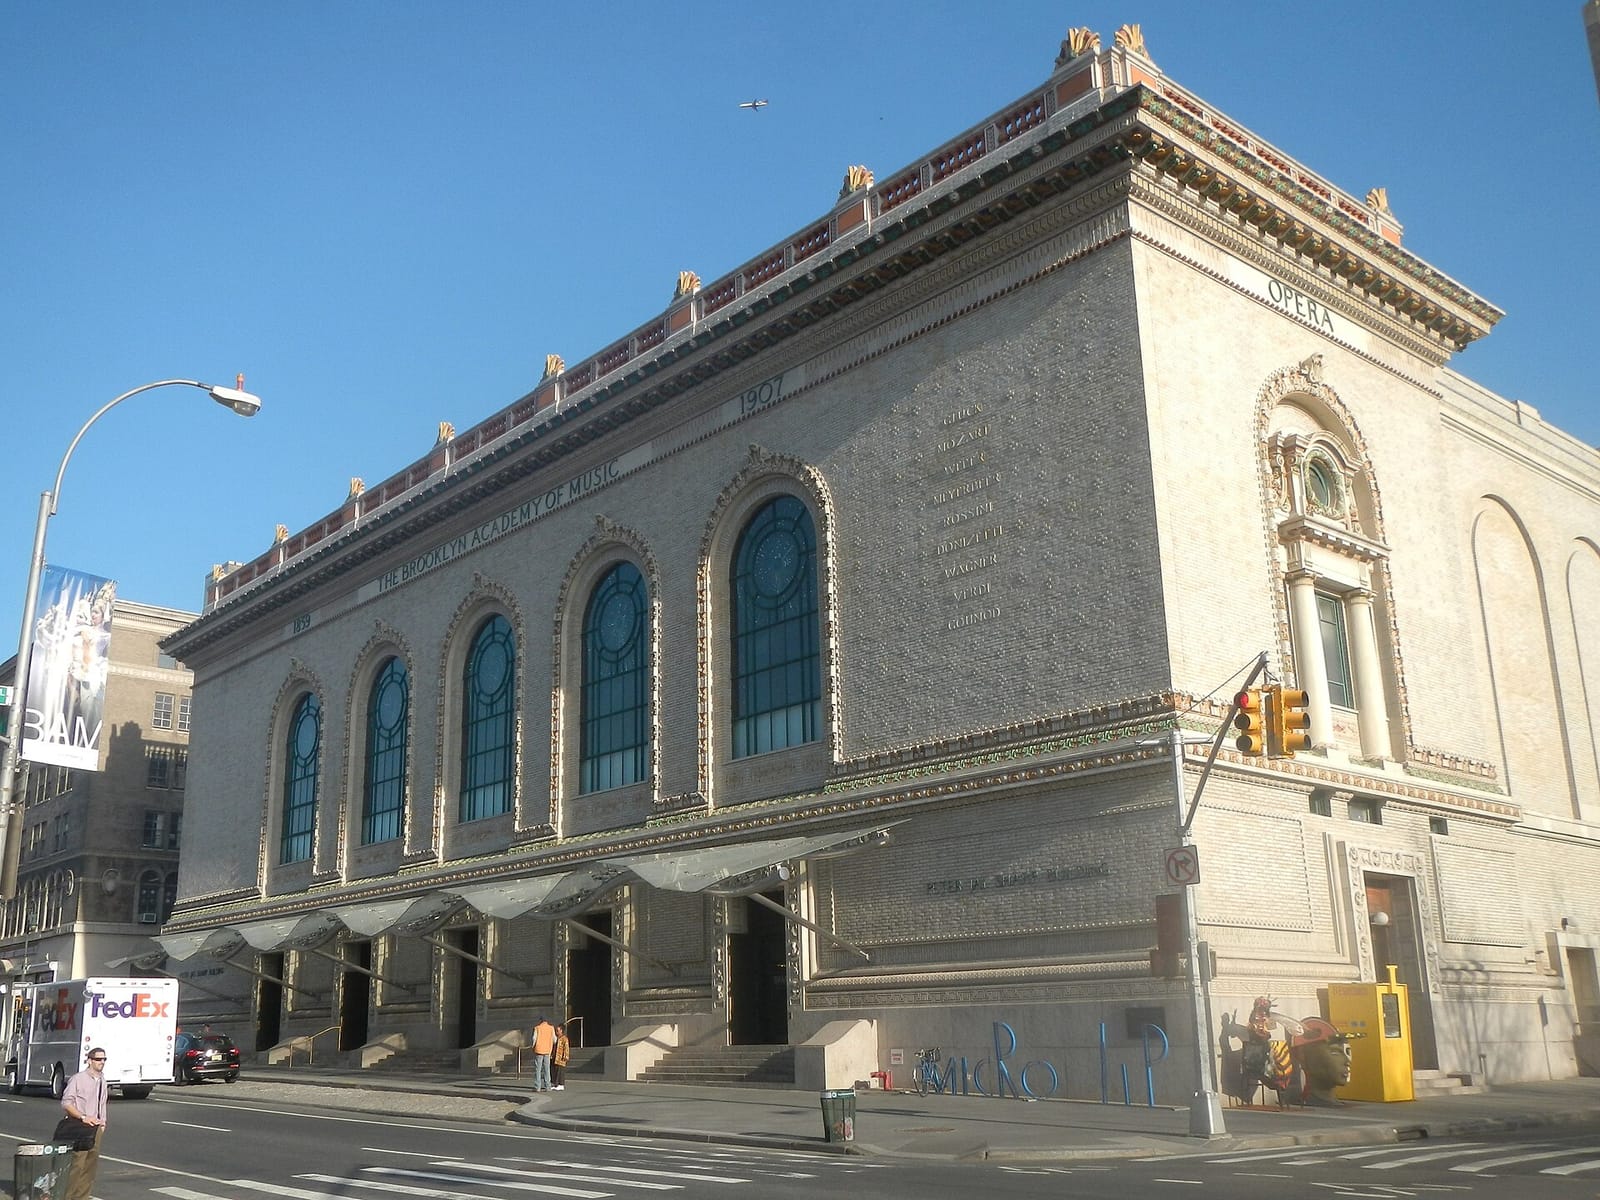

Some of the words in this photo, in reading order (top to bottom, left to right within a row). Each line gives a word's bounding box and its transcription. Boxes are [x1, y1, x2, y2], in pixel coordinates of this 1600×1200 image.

[1268, 279, 1334, 333] OPERA
[740, 374, 785, 415] 1907
[943, 402, 983, 426] GLUCK
[936, 423, 992, 454] MOZART
[377, 567, 400, 593] THE
[401, 534, 468, 582] BROOKLYN
[471, 499, 549, 546] ACADEMY
[545, 486, 565, 510] OF
[568, 458, 620, 499] MUSIC
[943, 501, 994, 529] ROSSINI
[936, 525, 1004, 556] DONIZETTI
[943, 553, 998, 579] WAGNER
[953, 583, 992, 602] VERDI
[947, 606, 1001, 632] GOUNOD
[23, 708, 103, 750] BAM
[91, 993, 169, 1018] FedEx
